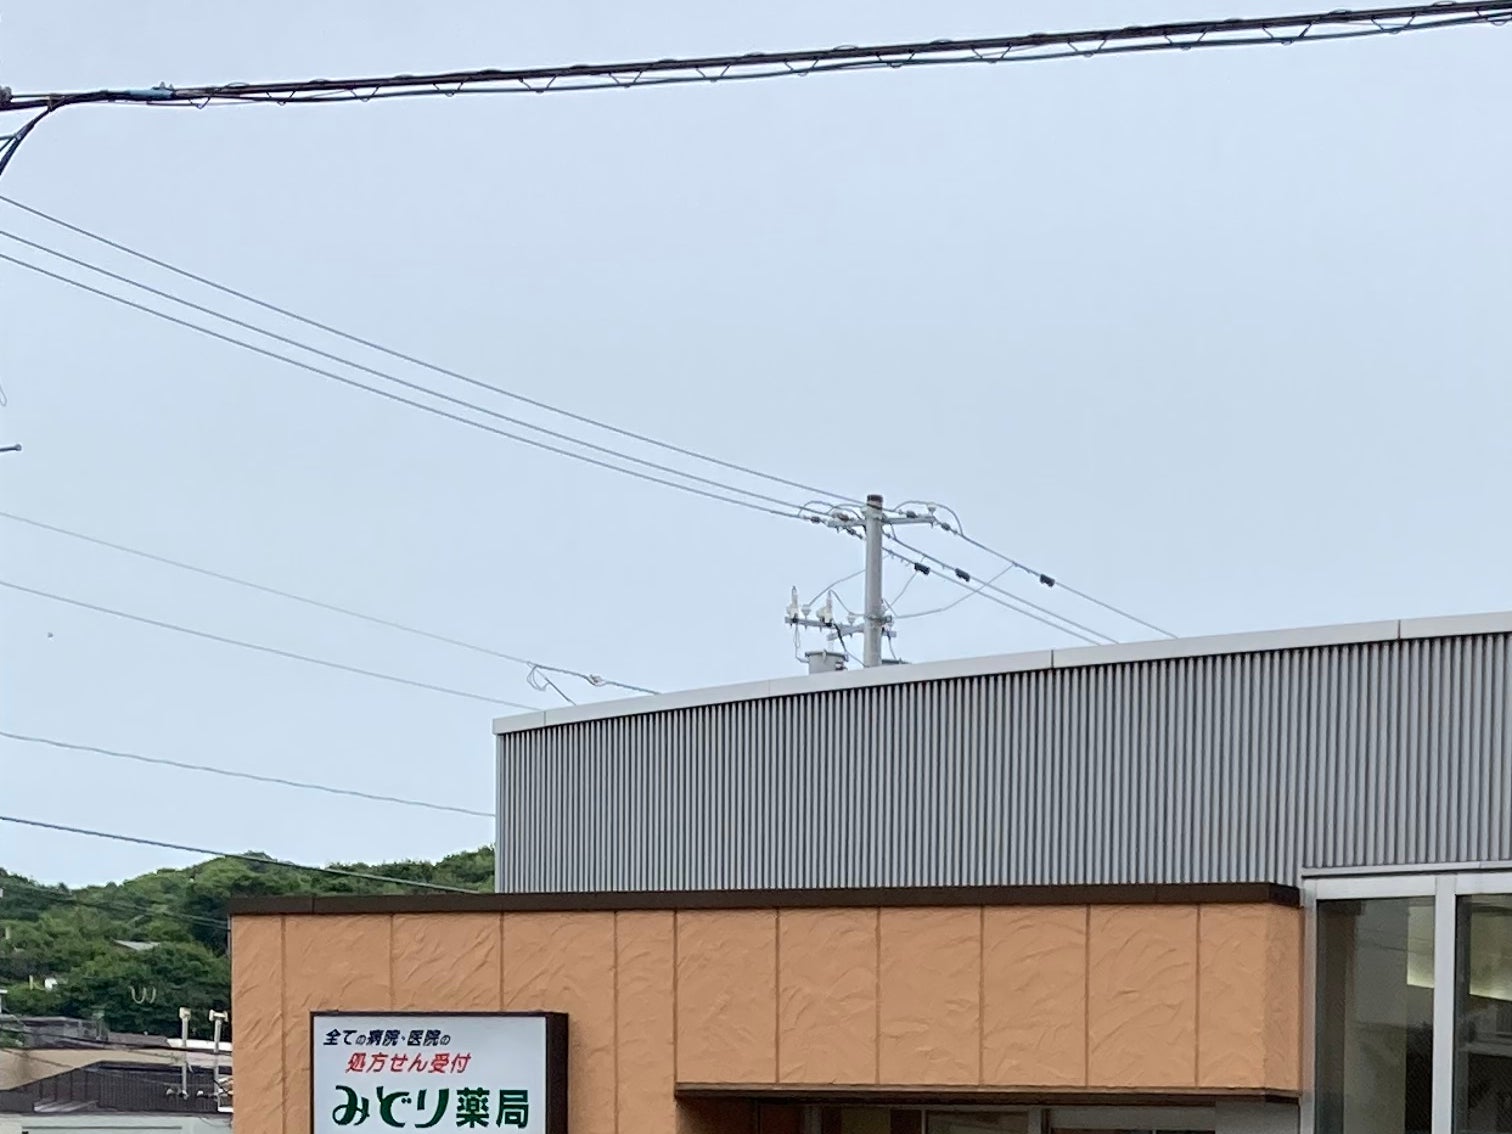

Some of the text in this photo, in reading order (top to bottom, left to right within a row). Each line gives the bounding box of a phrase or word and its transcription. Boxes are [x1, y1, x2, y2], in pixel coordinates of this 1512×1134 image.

[323, 1029, 451, 1046] 全ての病院・医院の
[345, 1053, 472, 1073] 処方せん受付
[332, 1085, 530, 1129] みどり薬局
